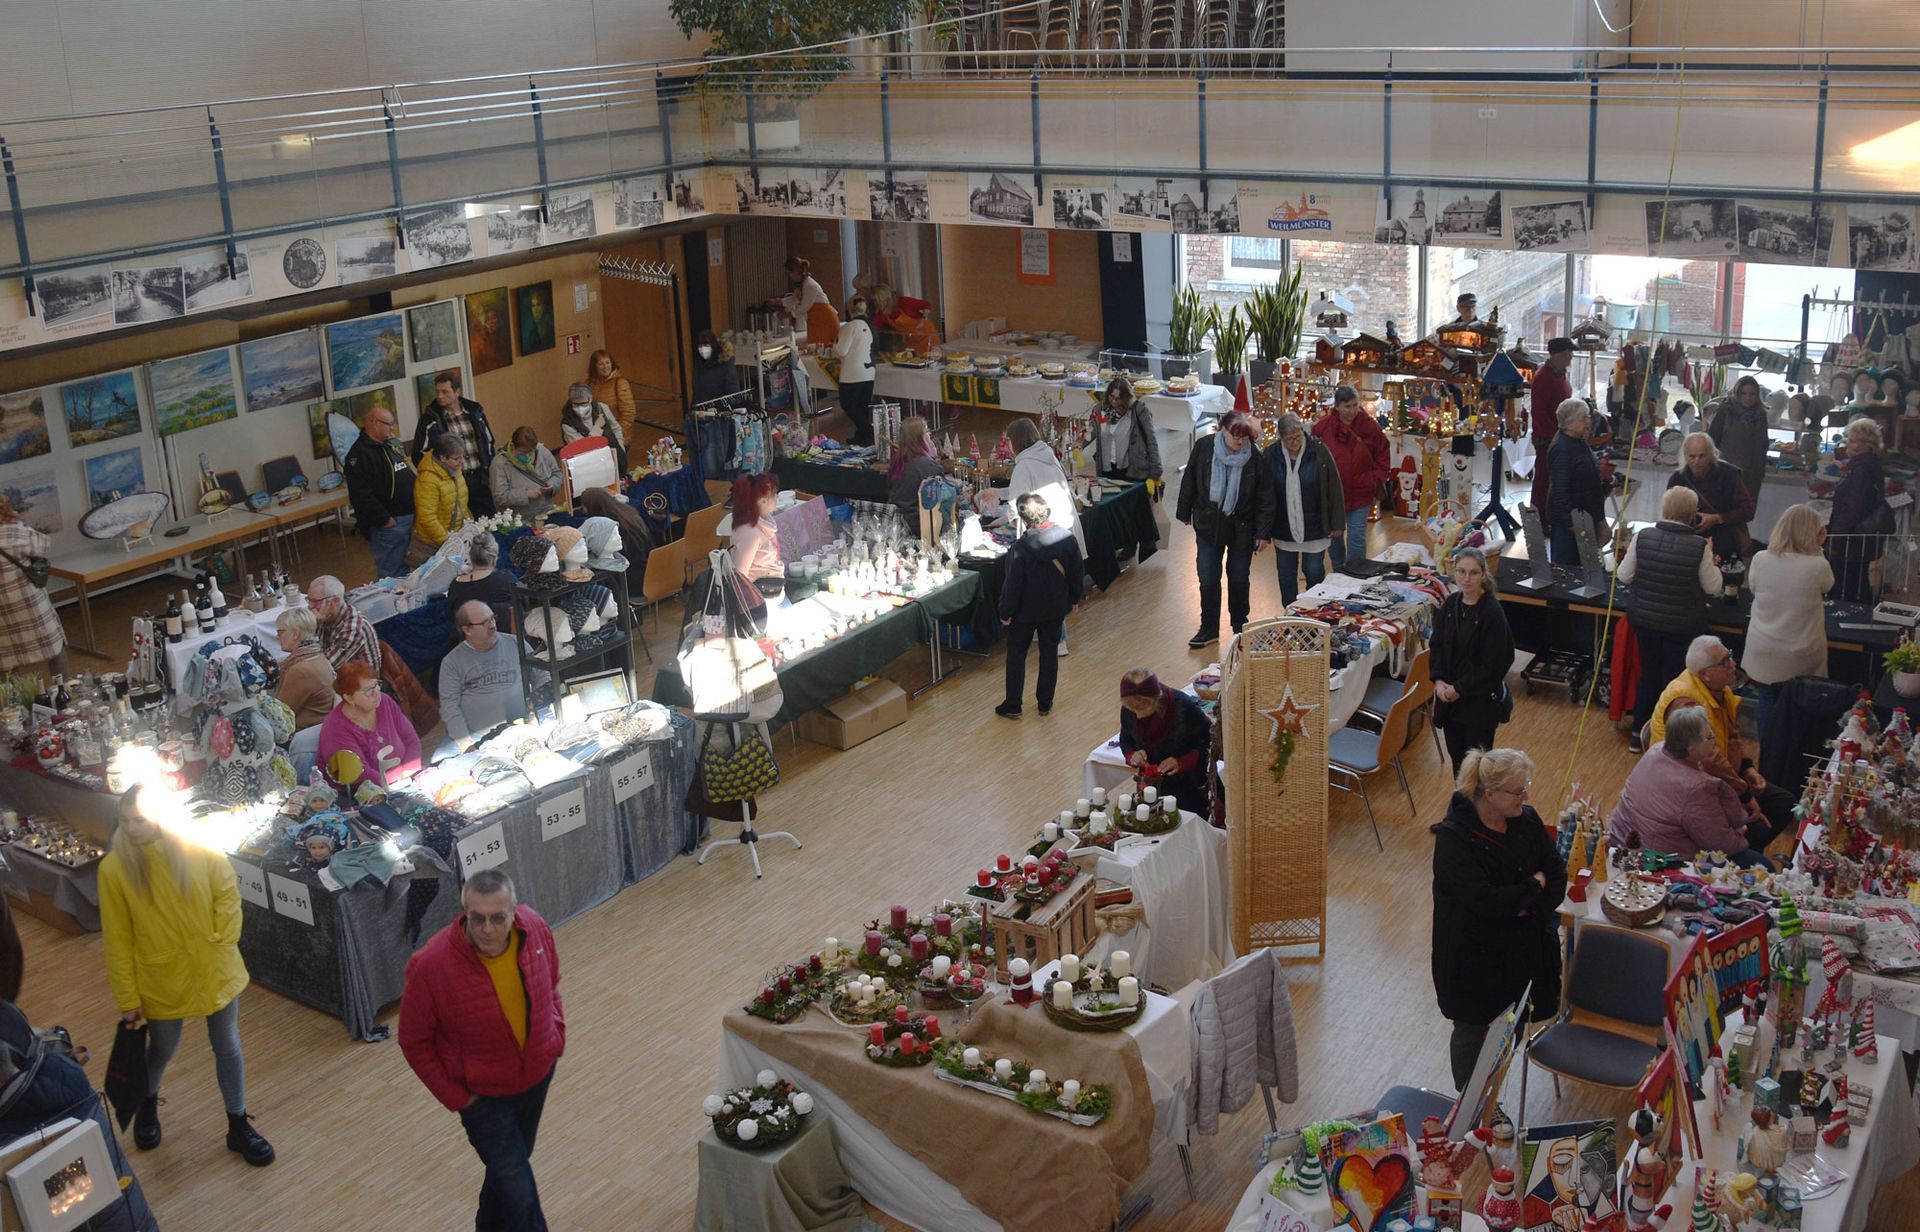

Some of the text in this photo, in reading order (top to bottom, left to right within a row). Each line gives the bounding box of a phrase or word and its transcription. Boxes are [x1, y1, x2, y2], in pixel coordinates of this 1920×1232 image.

[1309, 194, 1316, 205] 8
[1270, 219, 1331, 230] WEILMÜNSTER
[617, 775, 630, 789] 55
[637, 765, 648, 778] 57
[546, 812, 560, 826] 53
[568, 804, 581, 817] 55
[465, 851, 478, 866] 51
[486, 840, 500, 853] 53
[251, 882, 263, 893] 49
[276, 890, 288, 902] 49
[296, 897, 308, 910] 51
